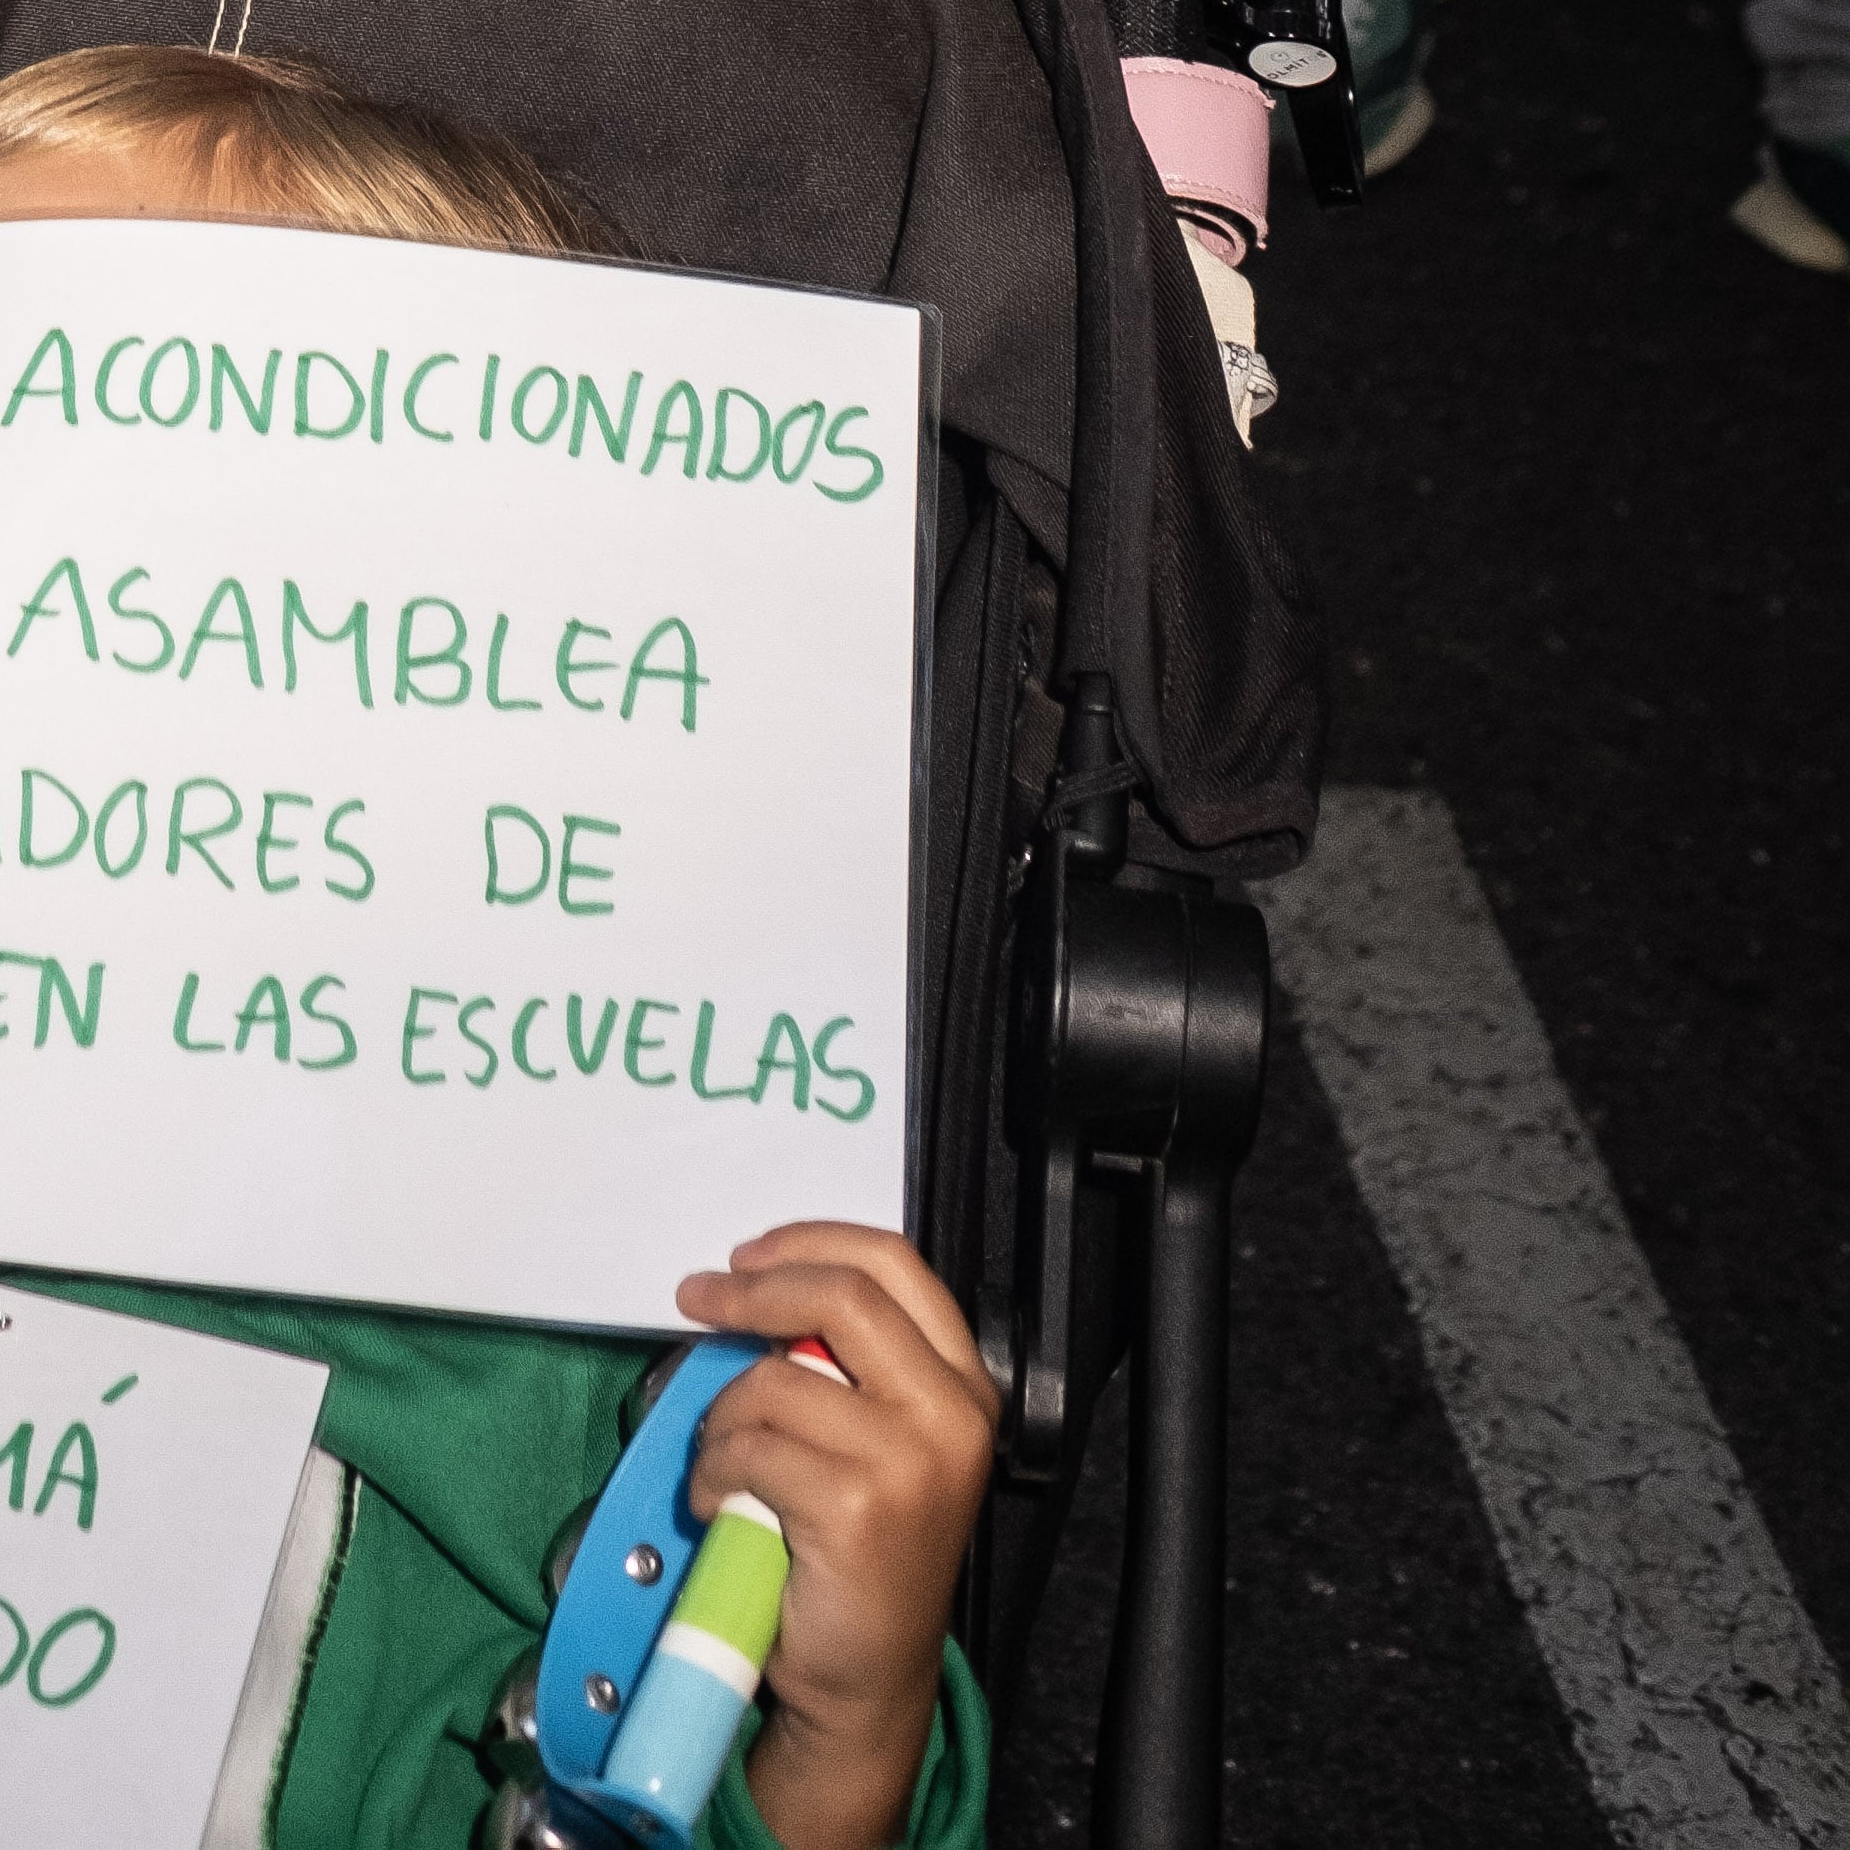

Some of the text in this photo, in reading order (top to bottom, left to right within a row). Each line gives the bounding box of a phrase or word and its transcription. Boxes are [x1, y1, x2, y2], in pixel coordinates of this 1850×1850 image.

[0, 327, 885, 505] ACONDICIONADOS
[6, 556, 710, 733] ASAMBLEA
[484, 804, 622, 916] DE
[171, 972, 359, 1070] LAS
[400, 986, 877, 1124] ESCUELAS
